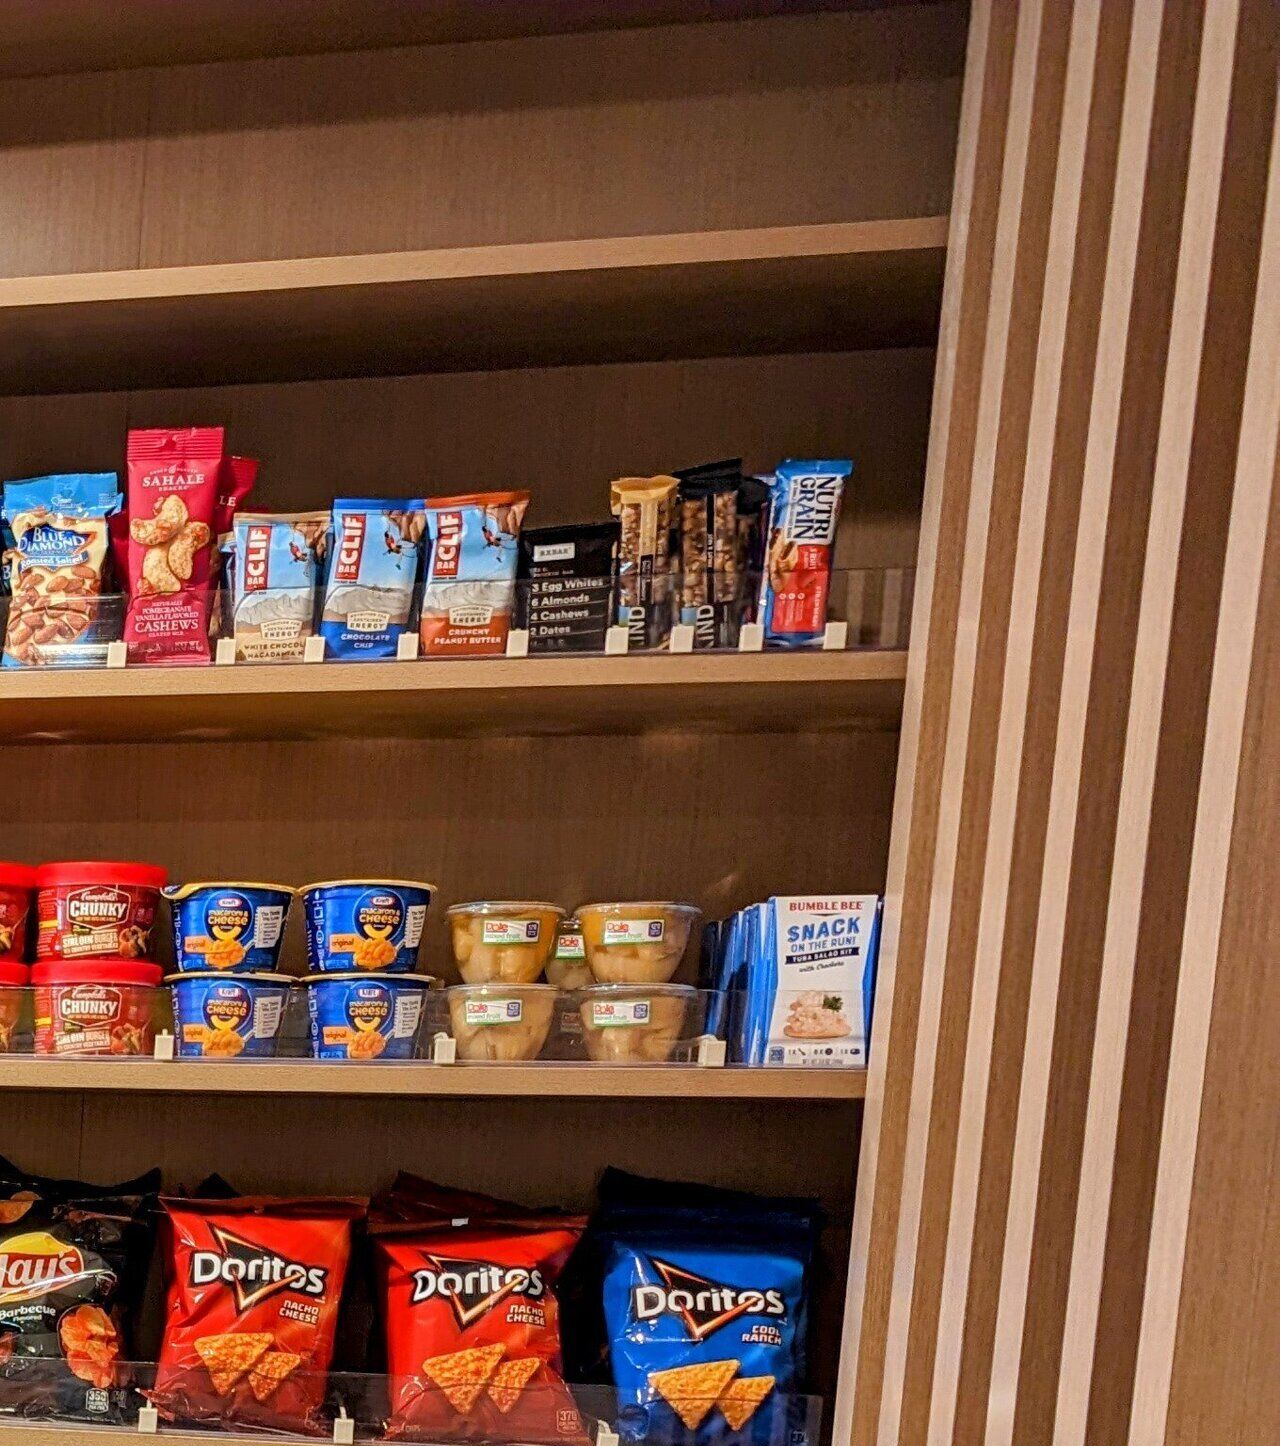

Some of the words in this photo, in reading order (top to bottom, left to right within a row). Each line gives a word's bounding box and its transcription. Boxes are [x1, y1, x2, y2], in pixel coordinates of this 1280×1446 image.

[142, 473, 205, 488] SAHALE
[17, 534, 87, 552] DIAMOND
[34, 527, 66, 543] BLUE
[338, 514, 365, 564] CLIF
[246, 528, 269, 576] CLIF
[337, 564, 357, 574] BAR
[246, 576, 266, 585] BAR
[532, 583, 539, 592] 3
[541, 580, 561, 593] Egg
[565, 577, 604, 589] Whites
[134, 618, 199, 632] CASHEWS
[448, 628, 489, 637] CRUNCHY
[70, 901, 127, 917] CHUNKY
[789, 901, 837, 911] BUMBLE
[840, 901, 863, 911] BEE
[787, 916, 860, 942] SNACK
[194, 1252, 326, 1294] Doritos
[412, 1268, 543, 1302] Doritos
[283, 1300, 319, 1316] NACHO
[510, 1304, 544, 1316] NACHO
[635, 1285, 785, 1319] Doritos
[279, 1308, 318, 1325] CHEESE
[506, 1312, 546, 1327] CHEESE
[752, 1325, 780, 1336] COOL
[741, 1333, 783, 1345] RANCH
